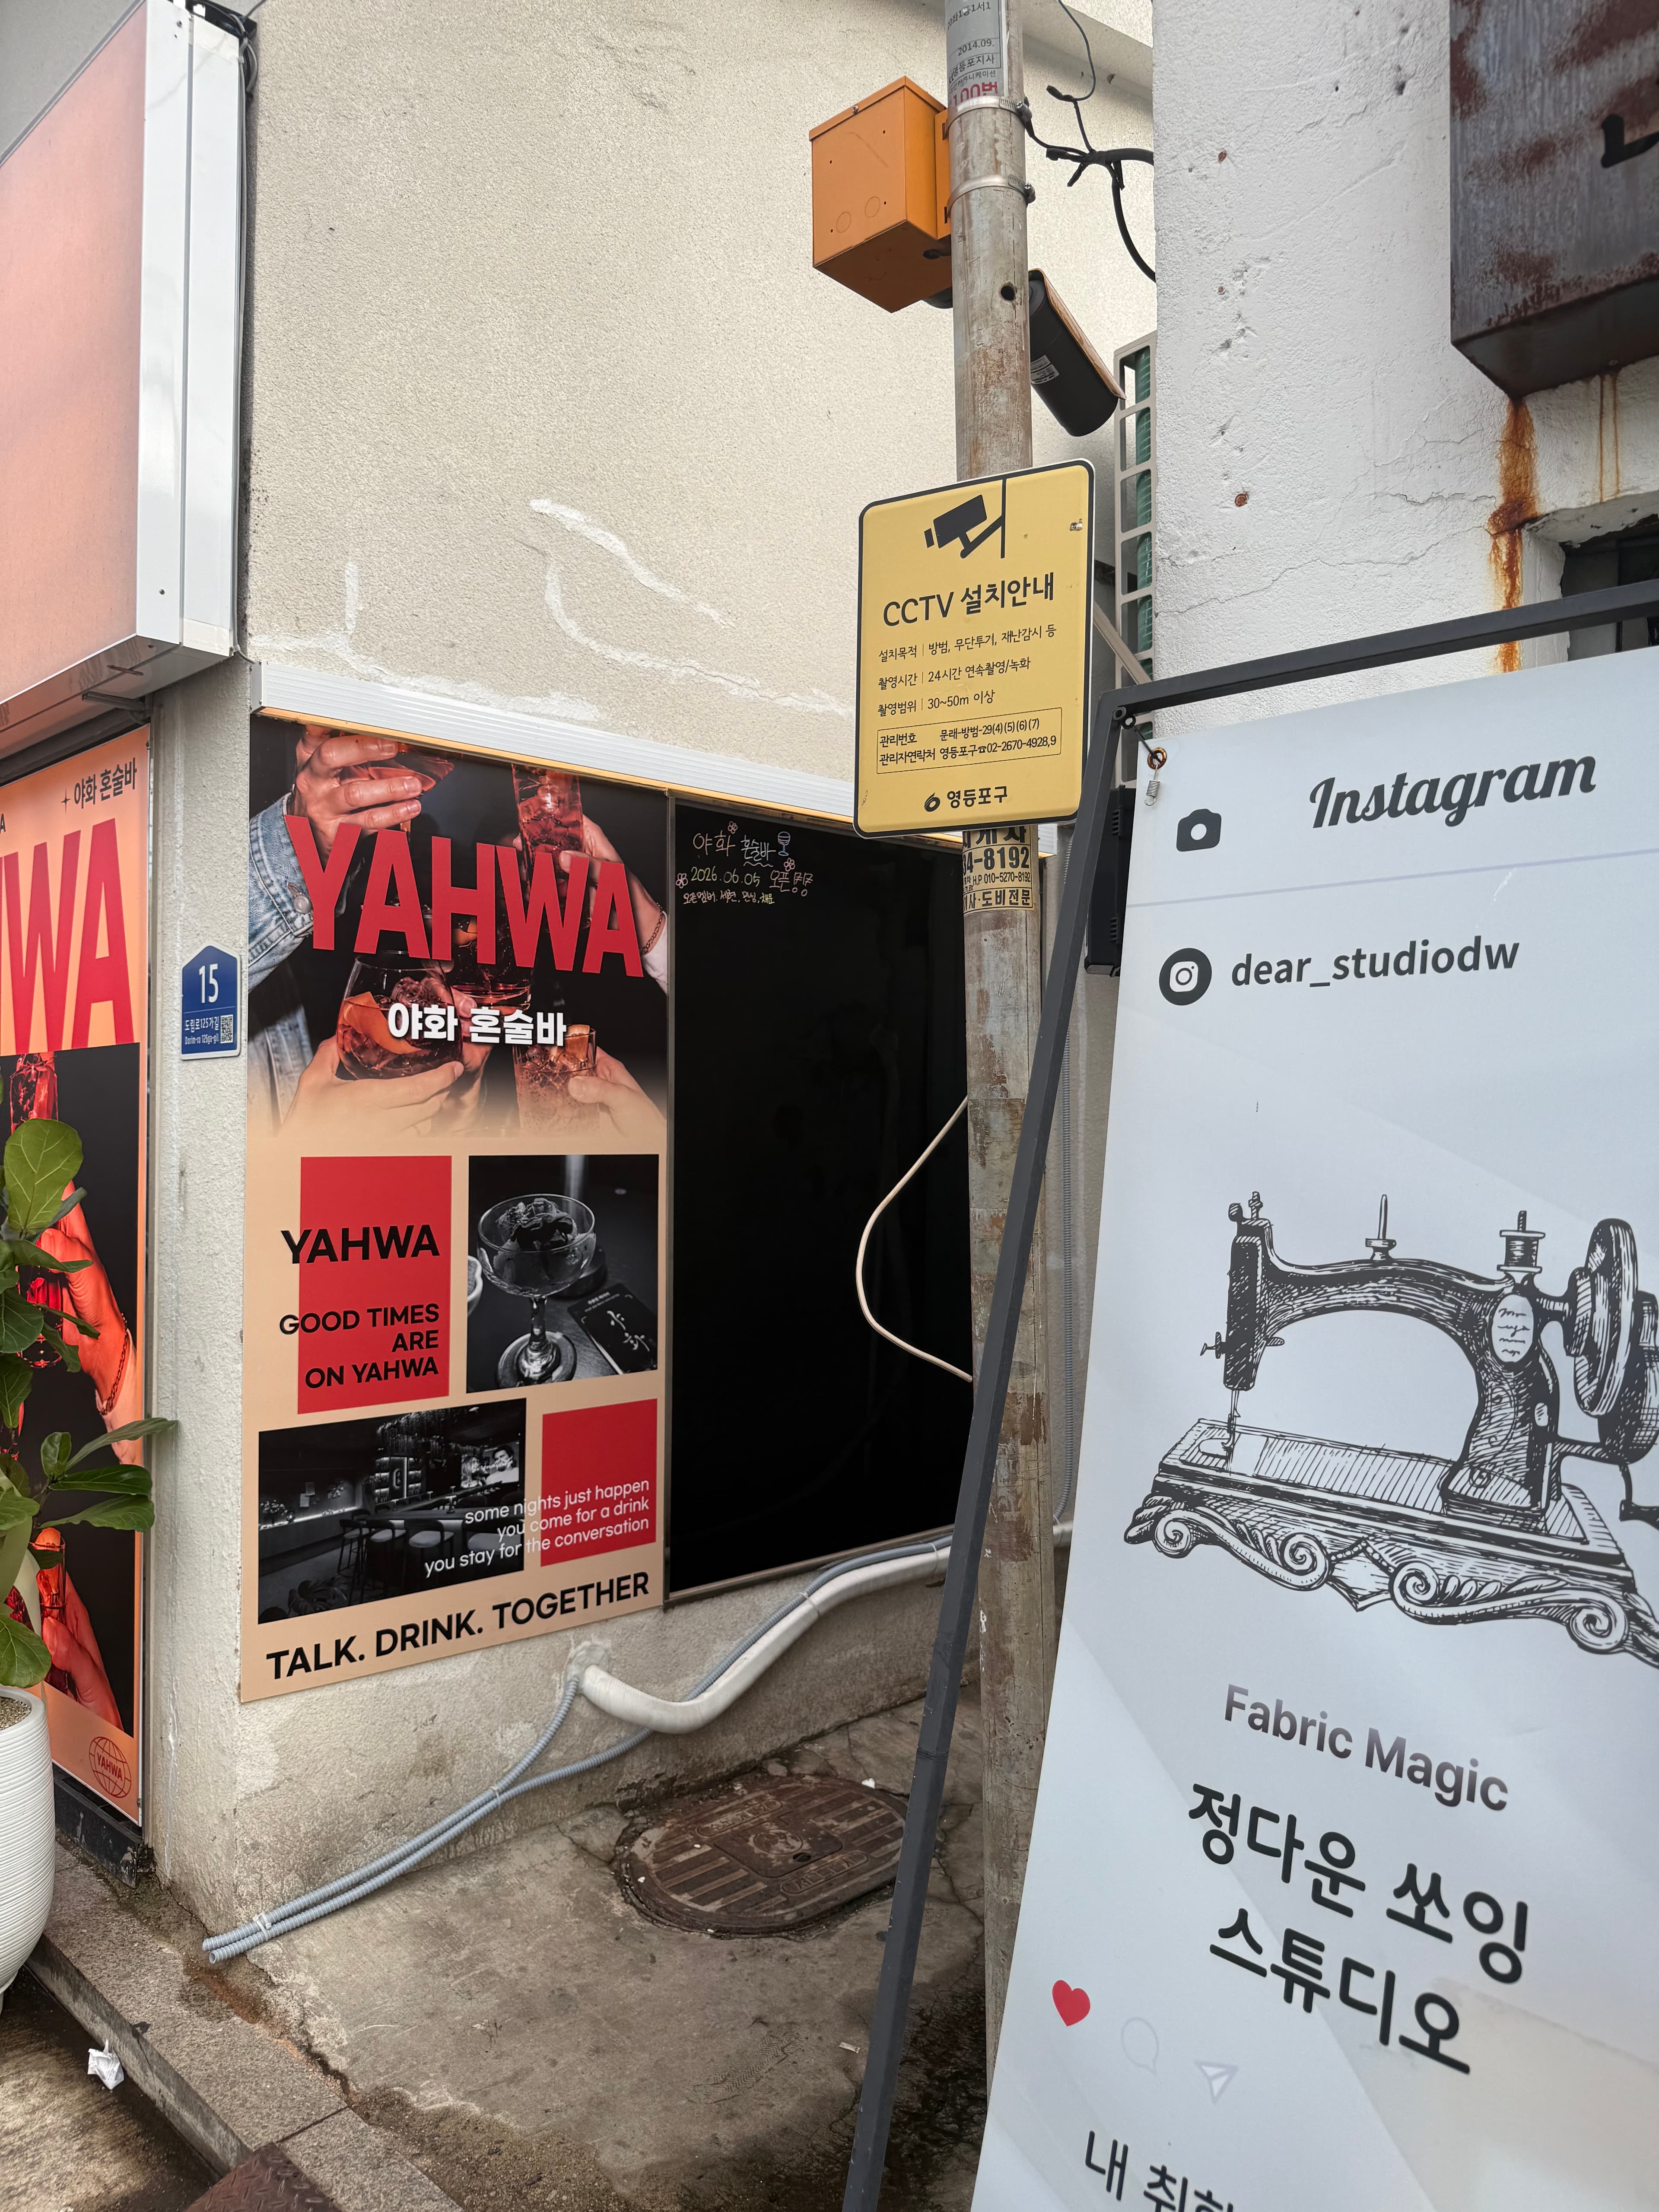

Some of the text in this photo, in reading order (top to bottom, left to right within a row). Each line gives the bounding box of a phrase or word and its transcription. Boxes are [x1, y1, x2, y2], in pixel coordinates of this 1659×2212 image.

[883, 572, 1054, 626] CCTV 설치안내
[879, 624, 1056, 662] 설치목적 방범, 무단투기, 재난감시 등
[878, 657, 1031, 690] 촬영시간 24시간 연속촬영/녹화
[878, 690, 995, 717] 촬영범위 30~50m 이상
[879, 748, 935, 766] 관리자연락처
[880, 733, 917, 747] 관리번호
[74, 757, 137, 809] 야화 혼술바
[947, 786, 1007, 808] 영등포구
[1309, 756, 1596, 829] Instagram
[693, 830, 776, 861] 야화 혼술바
[284, 814, 644, 977] YAHWA
[984, 872, 1030, 884] 010-5270-8192
[0, 818, 134, 1055] WA
[1232, 935, 1519, 988] dear_studiodw
[199, 963, 219, 1003] 15
[185, 1016, 219, 1033] 도림로125가길
[388, 1003, 566, 1046] 야화 혼술바
[281, 1224, 440, 1264] YAHWA
[279, 1303, 439, 1335] GOOD TIMES
[391, 1329, 439, 1352] ARE
[305, 1357, 439, 1389] ON YAHWA
[464, 1479, 649, 1524] some nights just happen
[497, 1496, 649, 1541] you come for a drink
[425, 1517, 649, 1578] you stay for the conversation
[267, 1571, 649, 1679] TALK. DRINK. TOGETHER
[97, 1752, 123, 1781] YAHWA
[1224, 1684, 1508, 1812] Fabric Magic
[1189, 1783, 1529, 1984] 정다운 쏘잉
[1210, 1908, 1470, 2075] 스튜디오
[1085, 2130, 1128, 2201] 내
